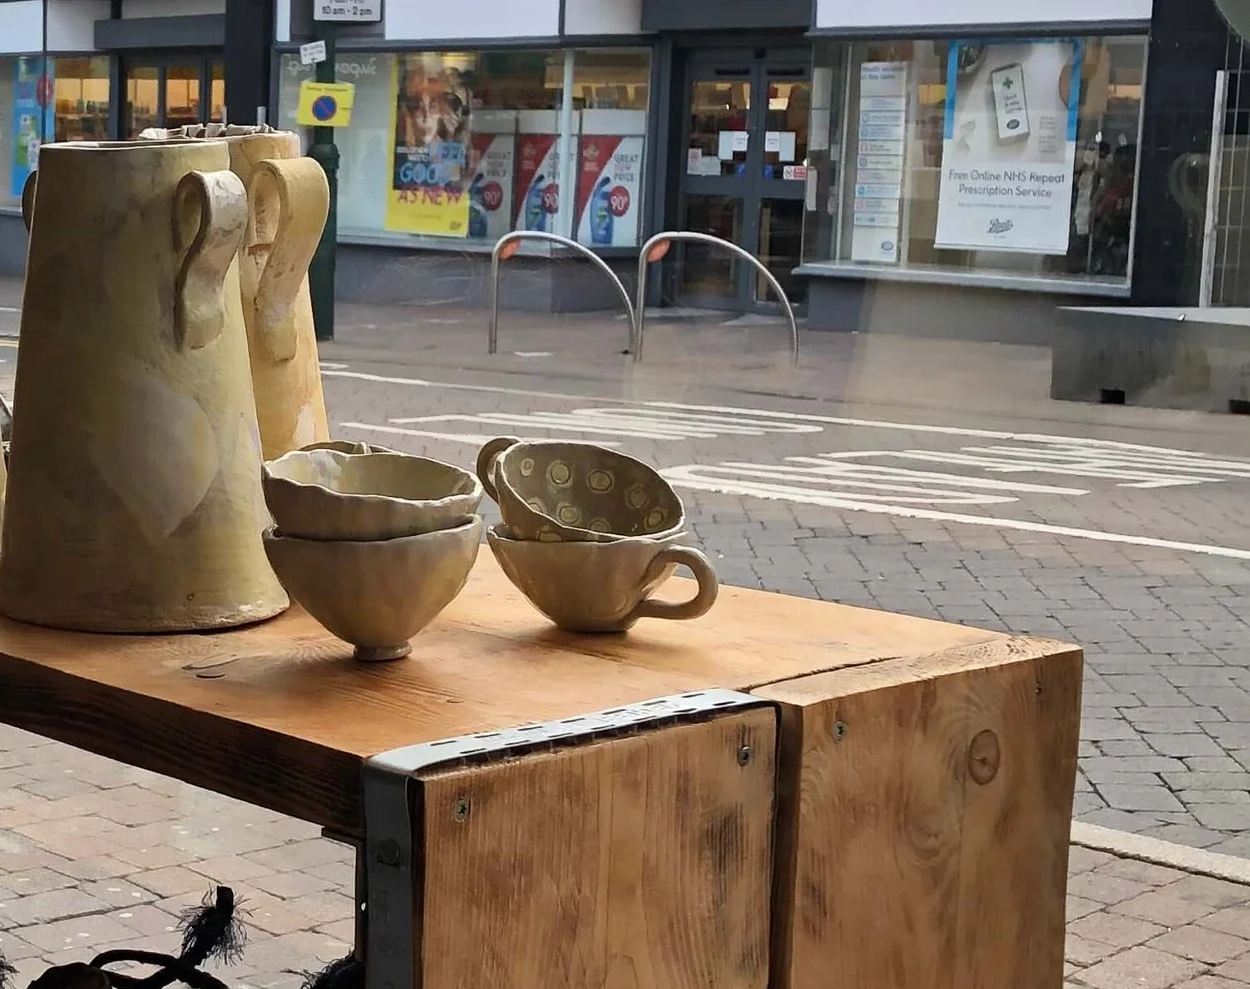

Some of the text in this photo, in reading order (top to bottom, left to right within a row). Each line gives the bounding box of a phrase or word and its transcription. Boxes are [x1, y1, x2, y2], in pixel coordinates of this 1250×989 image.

[322, 6, 331, 15] 10
[352, 6, 359, 15] 2
[360, 8, 373, 16] pm
[948, 168, 1065, 185] Free Online NHS Repeat
[958, 183, 1052, 198] Prescription Service
